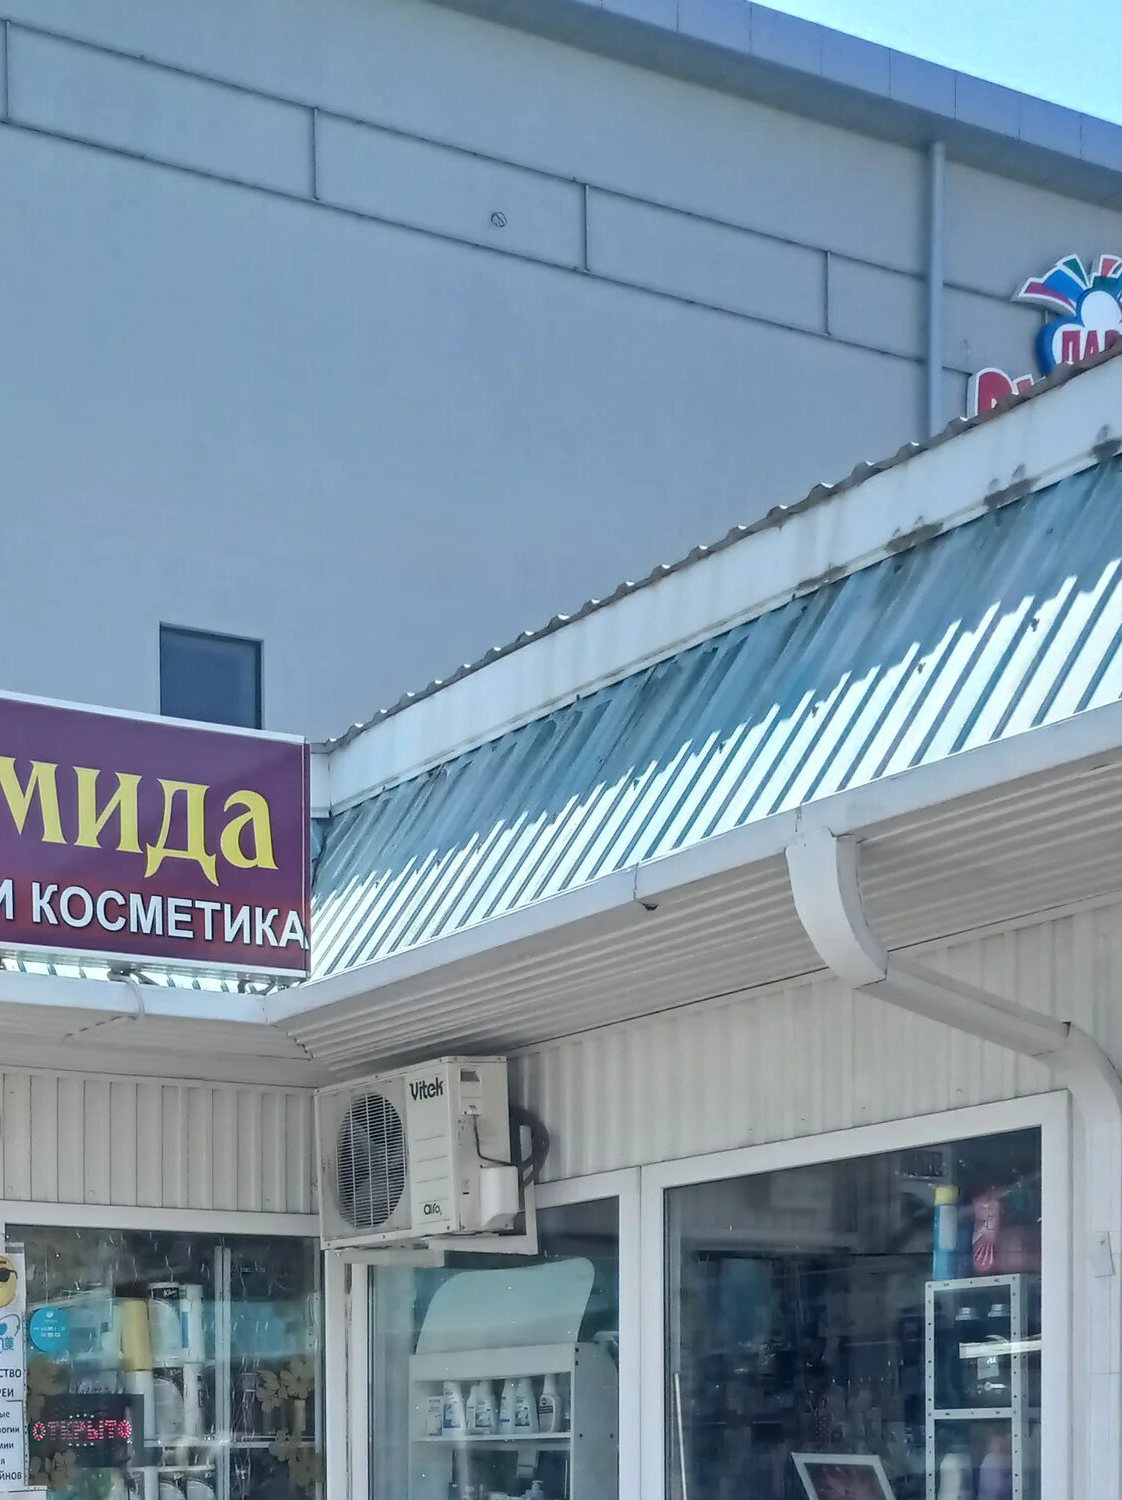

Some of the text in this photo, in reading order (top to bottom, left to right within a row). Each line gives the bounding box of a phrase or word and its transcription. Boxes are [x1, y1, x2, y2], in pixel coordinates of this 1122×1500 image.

[31, 881, 309, 950] КОСМЕТИКА
[409, 1077, 444, 1101] Vitek
[32, 1419, 132, 1441] ОТКРЫТО
